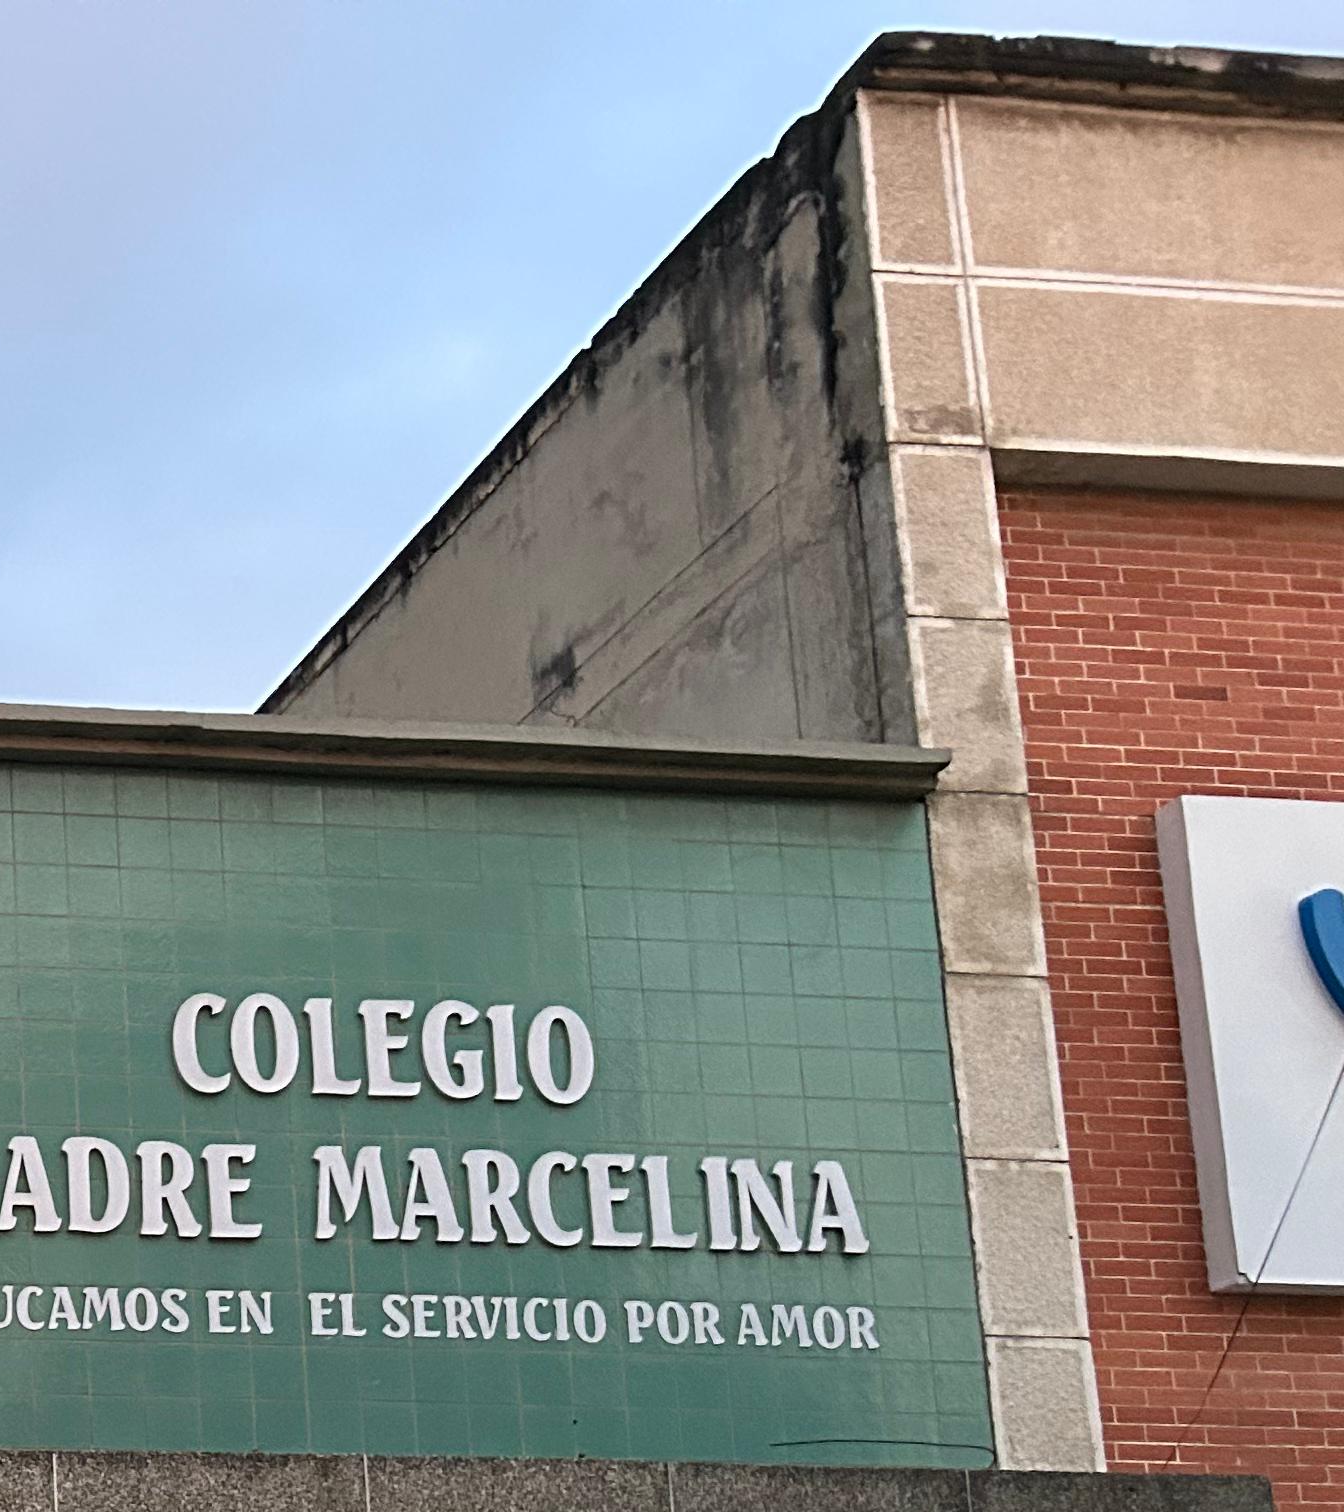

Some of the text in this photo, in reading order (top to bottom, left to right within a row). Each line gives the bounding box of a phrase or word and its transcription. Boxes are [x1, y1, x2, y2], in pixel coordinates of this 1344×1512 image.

[172, 991, 596, 1105] COLEGIO
[312, 1145, 870, 1255] MARCELINA
[205, 1289, 274, 1336] EN
[307, 1292, 368, 1338] EL
[381, 1293, 607, 1345] SERVICIO
[623, 1300, 726, 1346] POR
[737, 1302, 881, 1350] AMOR
